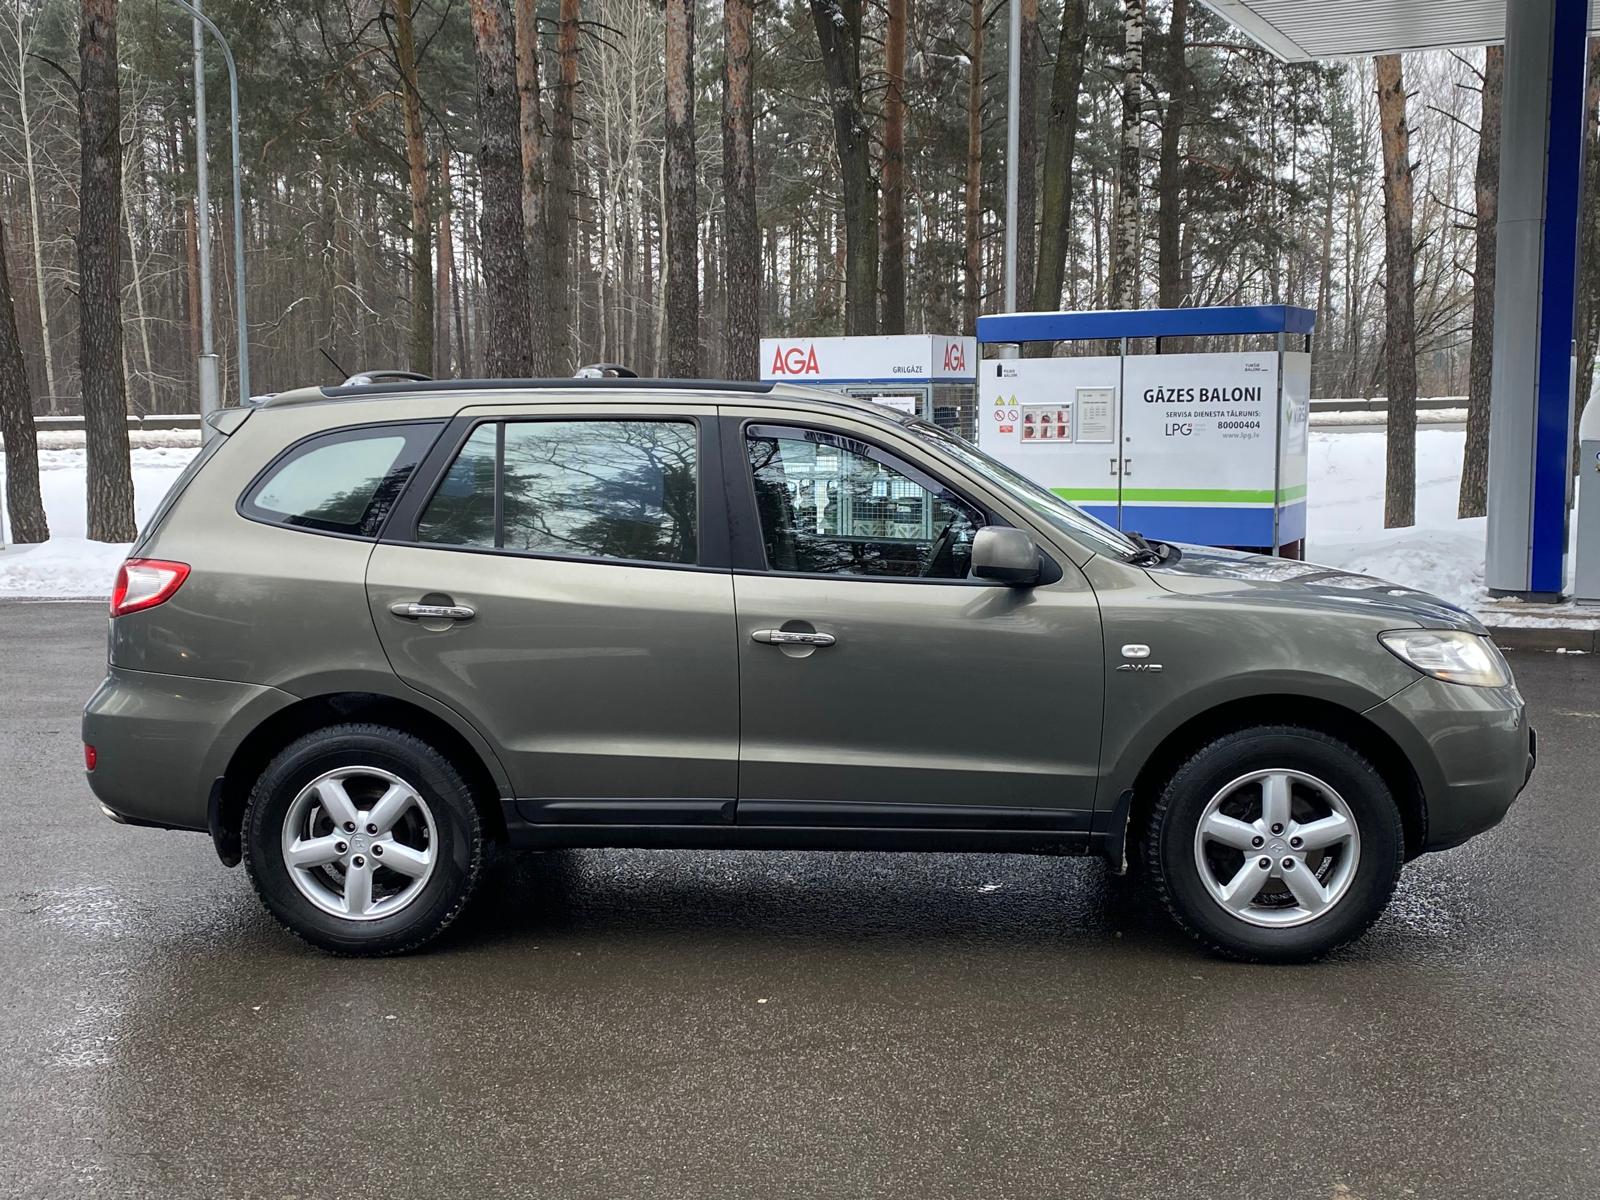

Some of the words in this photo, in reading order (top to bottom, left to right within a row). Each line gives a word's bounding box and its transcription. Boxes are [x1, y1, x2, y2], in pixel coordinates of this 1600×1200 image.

[771, 343, 820, 375] AGA
[943, 339, 966, 371] AGA
[1143, 385, 1195, 404] GĀZES
[1199, 386, 1262, 402] BALONI
[1165, 410, 1192, 418] SERVISA
[1193, 410, 1225, 418] DIENESTA
[1226, 409, 1261, 417] TĀLRUNIS:
[1165, 423, 1192, 436] LPG
[1217, 420, 1261, 429] 80000404
[1222, 431, 1260, 440] www.lpg.lv
